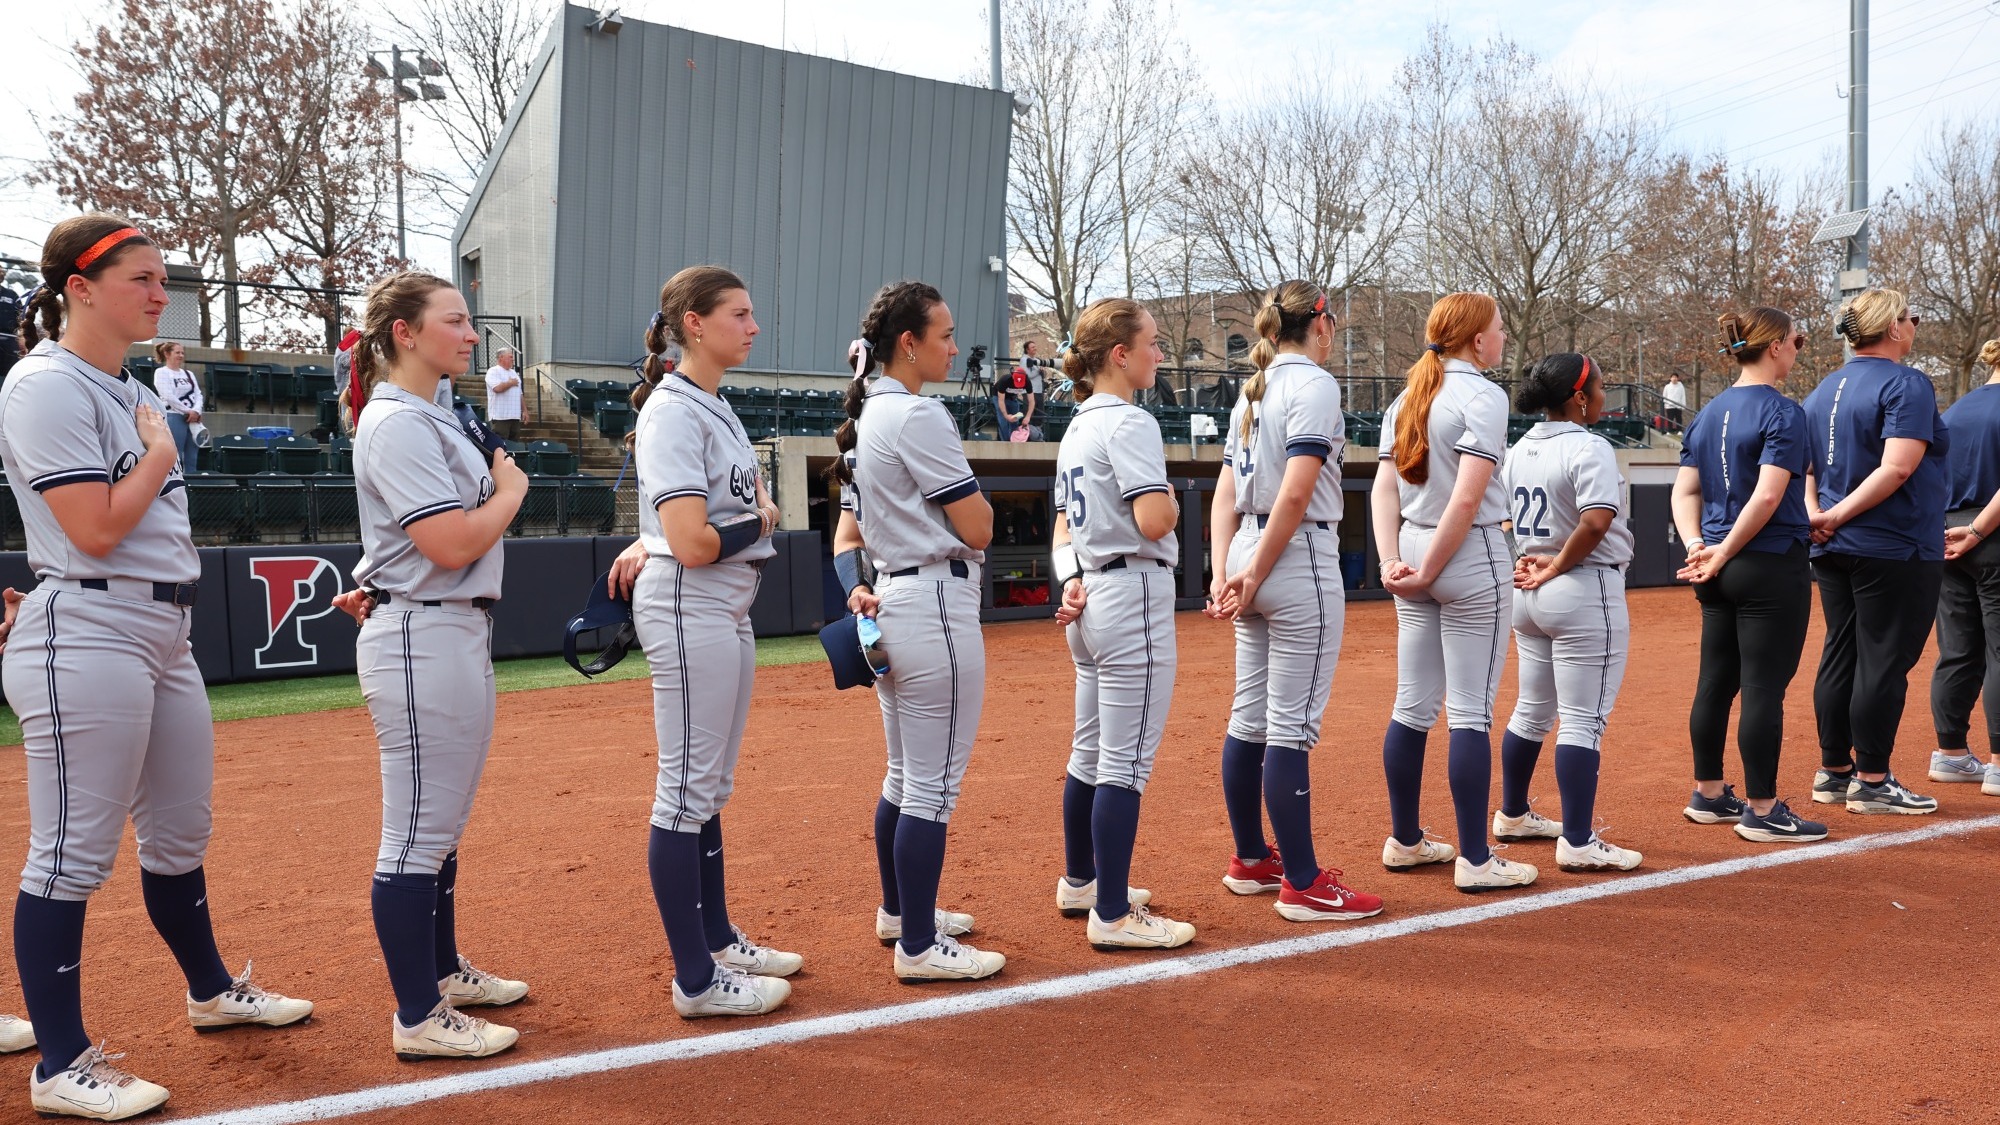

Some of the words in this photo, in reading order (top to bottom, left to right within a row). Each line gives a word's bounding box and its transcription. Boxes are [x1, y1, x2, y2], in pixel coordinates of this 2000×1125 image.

[1720, 410, 1731, 495] QUAKER
[1828, 377, 1847, 466] QUAKERS
[1514, 486, 1551, 537] 22
[249, 555, 343, 670] P
